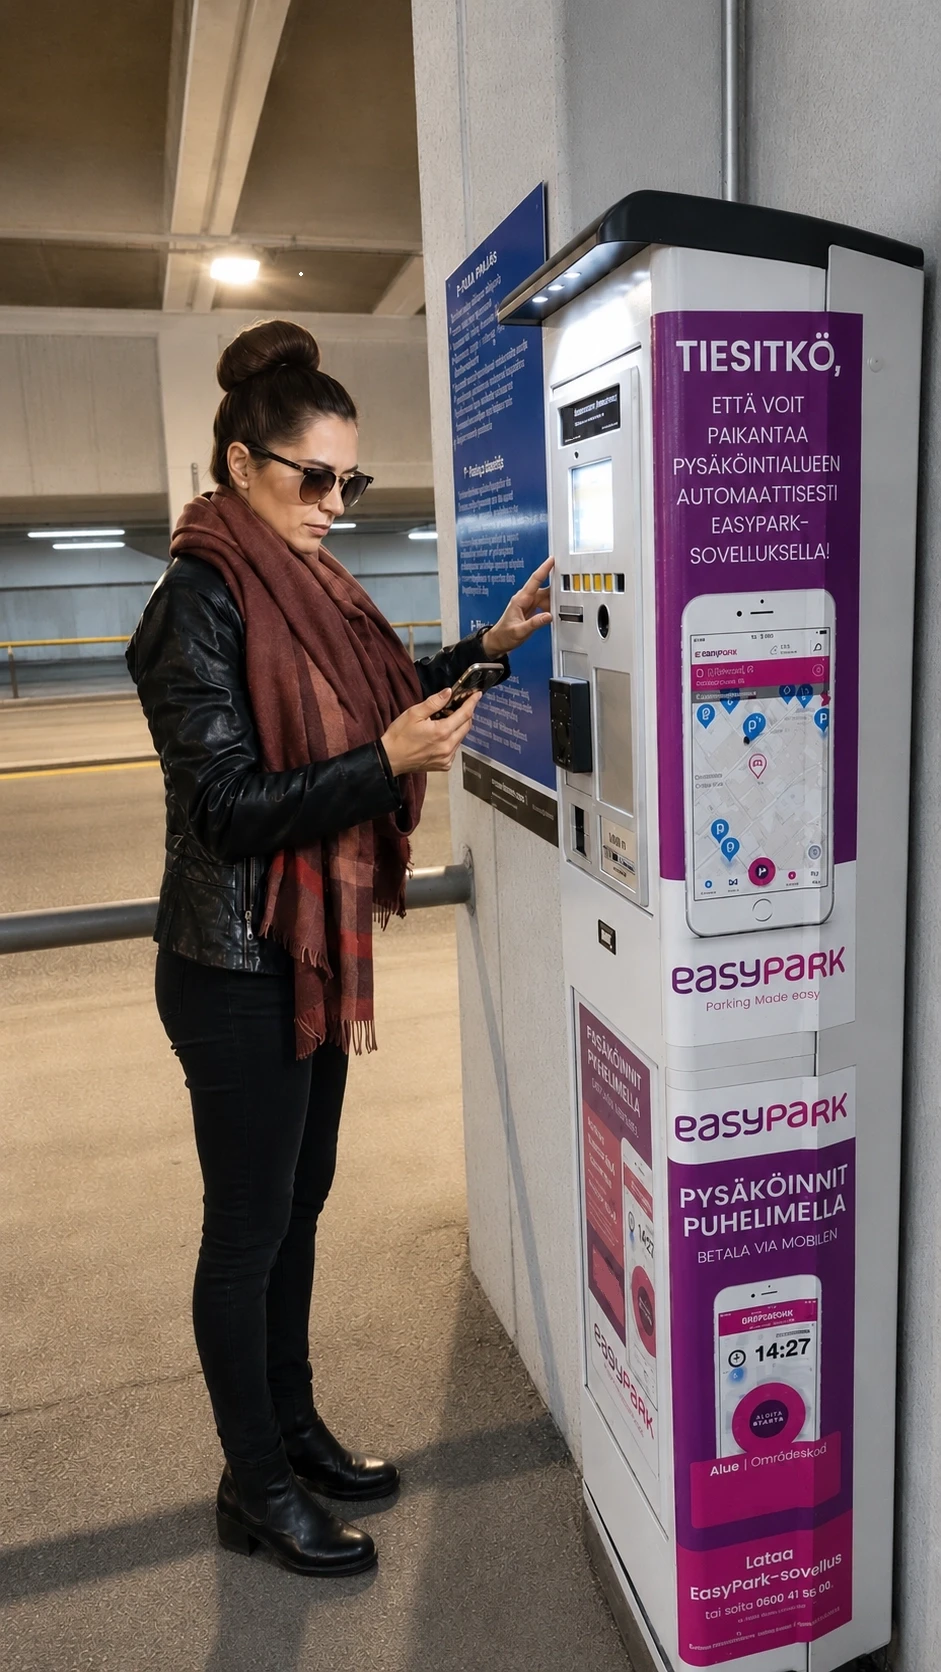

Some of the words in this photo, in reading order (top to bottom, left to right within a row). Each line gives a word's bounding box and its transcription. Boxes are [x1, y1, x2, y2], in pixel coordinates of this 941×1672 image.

[676, 332, 841, 377] TIESITKÖ,
[712, 393, 756, 414] ETTÄ
[762, 396, 804, 413] VOIT
[708, 426, 808, 444] PAIKANTAA
[673, 453, 841, 475] PYSÄKÖINTIALUEEN
[676, 484, 838, 505] AUTOMAATTISESTI
[712, 514, 808, 534] EASYPARK-
[690, 543, 830, 564] SOVELLUKSELLA!
[706, 997, 751, 1012] Parking
[755, 992, 788, 1005] Made
[792, 990, 820, 1001] easy
[680, 1163, 848, 1208] PYSÄKÖINNIT
[683, 1193, 847, 1237] PUHELIMELLA
[697, 1244, 750, 1264] BETALA
[754, 1239, 778, 1254] VIA
[782, 1227, 838, 1249] MOBILEN
[755, 1338, 811, 1362] 14:27
[709, 1462, 740, 1477] Alue
[745, 1549, 794, 1570] Lataa
[690, 1553, 842, 1600] EasyPark-sovellus
[705, 1607, 721, 1620] tai
[724, 1601, 754, 1616] soita
[756, 1593, 784, 1608] 0600
[788, 1589, 799, 1600] 41
